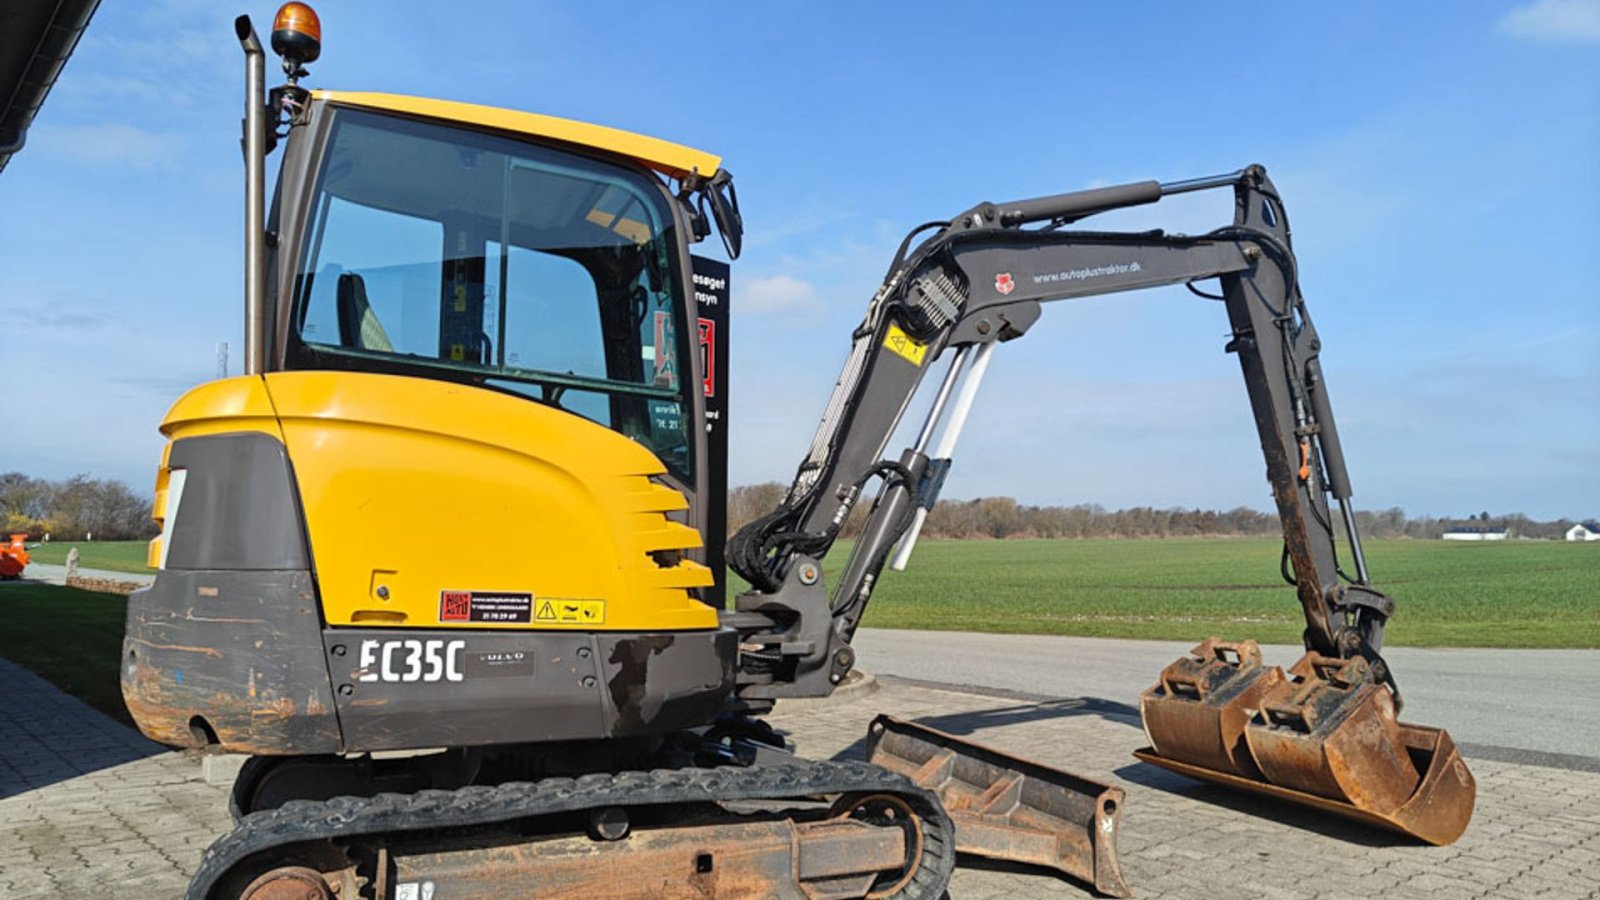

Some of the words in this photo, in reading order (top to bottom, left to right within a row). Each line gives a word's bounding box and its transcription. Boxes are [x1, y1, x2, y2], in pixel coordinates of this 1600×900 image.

[692, 273, 725, 290] esøget
[1032, 262, 1141, 283] www.autoplustraktor.dk
[694, 291, 718, 306] nsyn
[359, 639, 466, 682] EC35C
